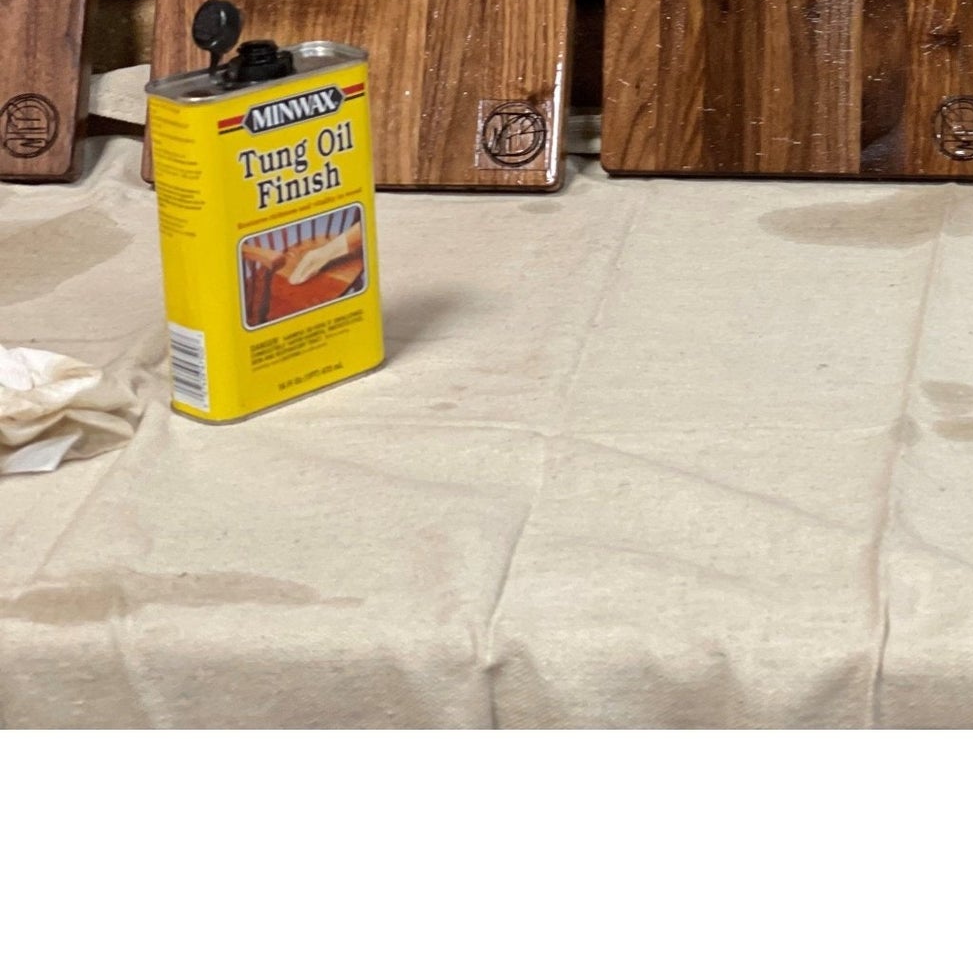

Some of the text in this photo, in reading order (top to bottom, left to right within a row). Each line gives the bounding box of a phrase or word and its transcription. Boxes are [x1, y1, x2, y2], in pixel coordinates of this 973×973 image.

[251, 89, 337, 132] MINWAX
[238, 121, 353, 179] Tung Oil
[256, 161, 341, 209] Finish
